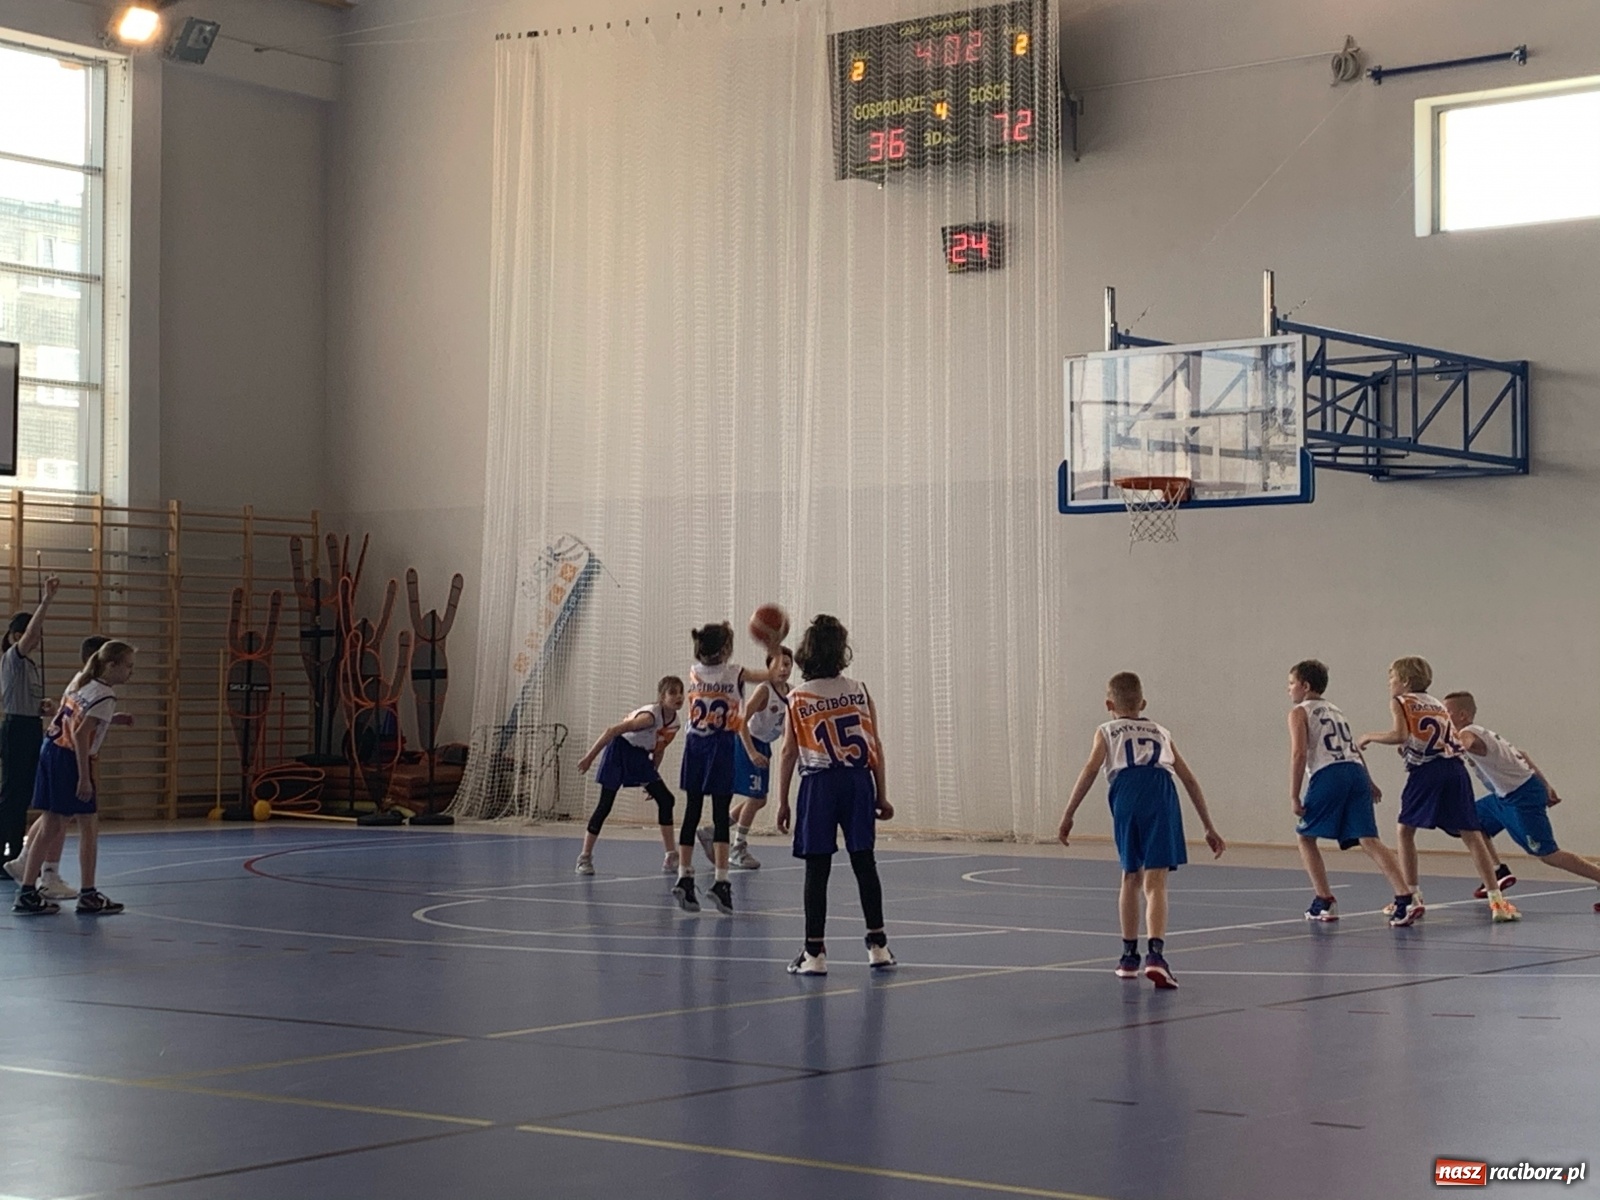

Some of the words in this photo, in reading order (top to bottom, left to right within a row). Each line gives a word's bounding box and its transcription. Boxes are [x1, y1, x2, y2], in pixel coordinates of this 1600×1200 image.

[1014, 33, 1028, 55] 2
[851, 61, 864, 81] 2
[854, 95, 926, 120] GOSPODARZE
[935, 102, 947, 119] 4
[993, 109, 1031, 141] 72
[869, 128, 905, 162] 36
[951, 232, 988, 263] 24
[799, 693, 865, 718] RACIBÓRZ
[1411, 703, 1446, 714] RACIB
[814, 714, 868, 768] 15
